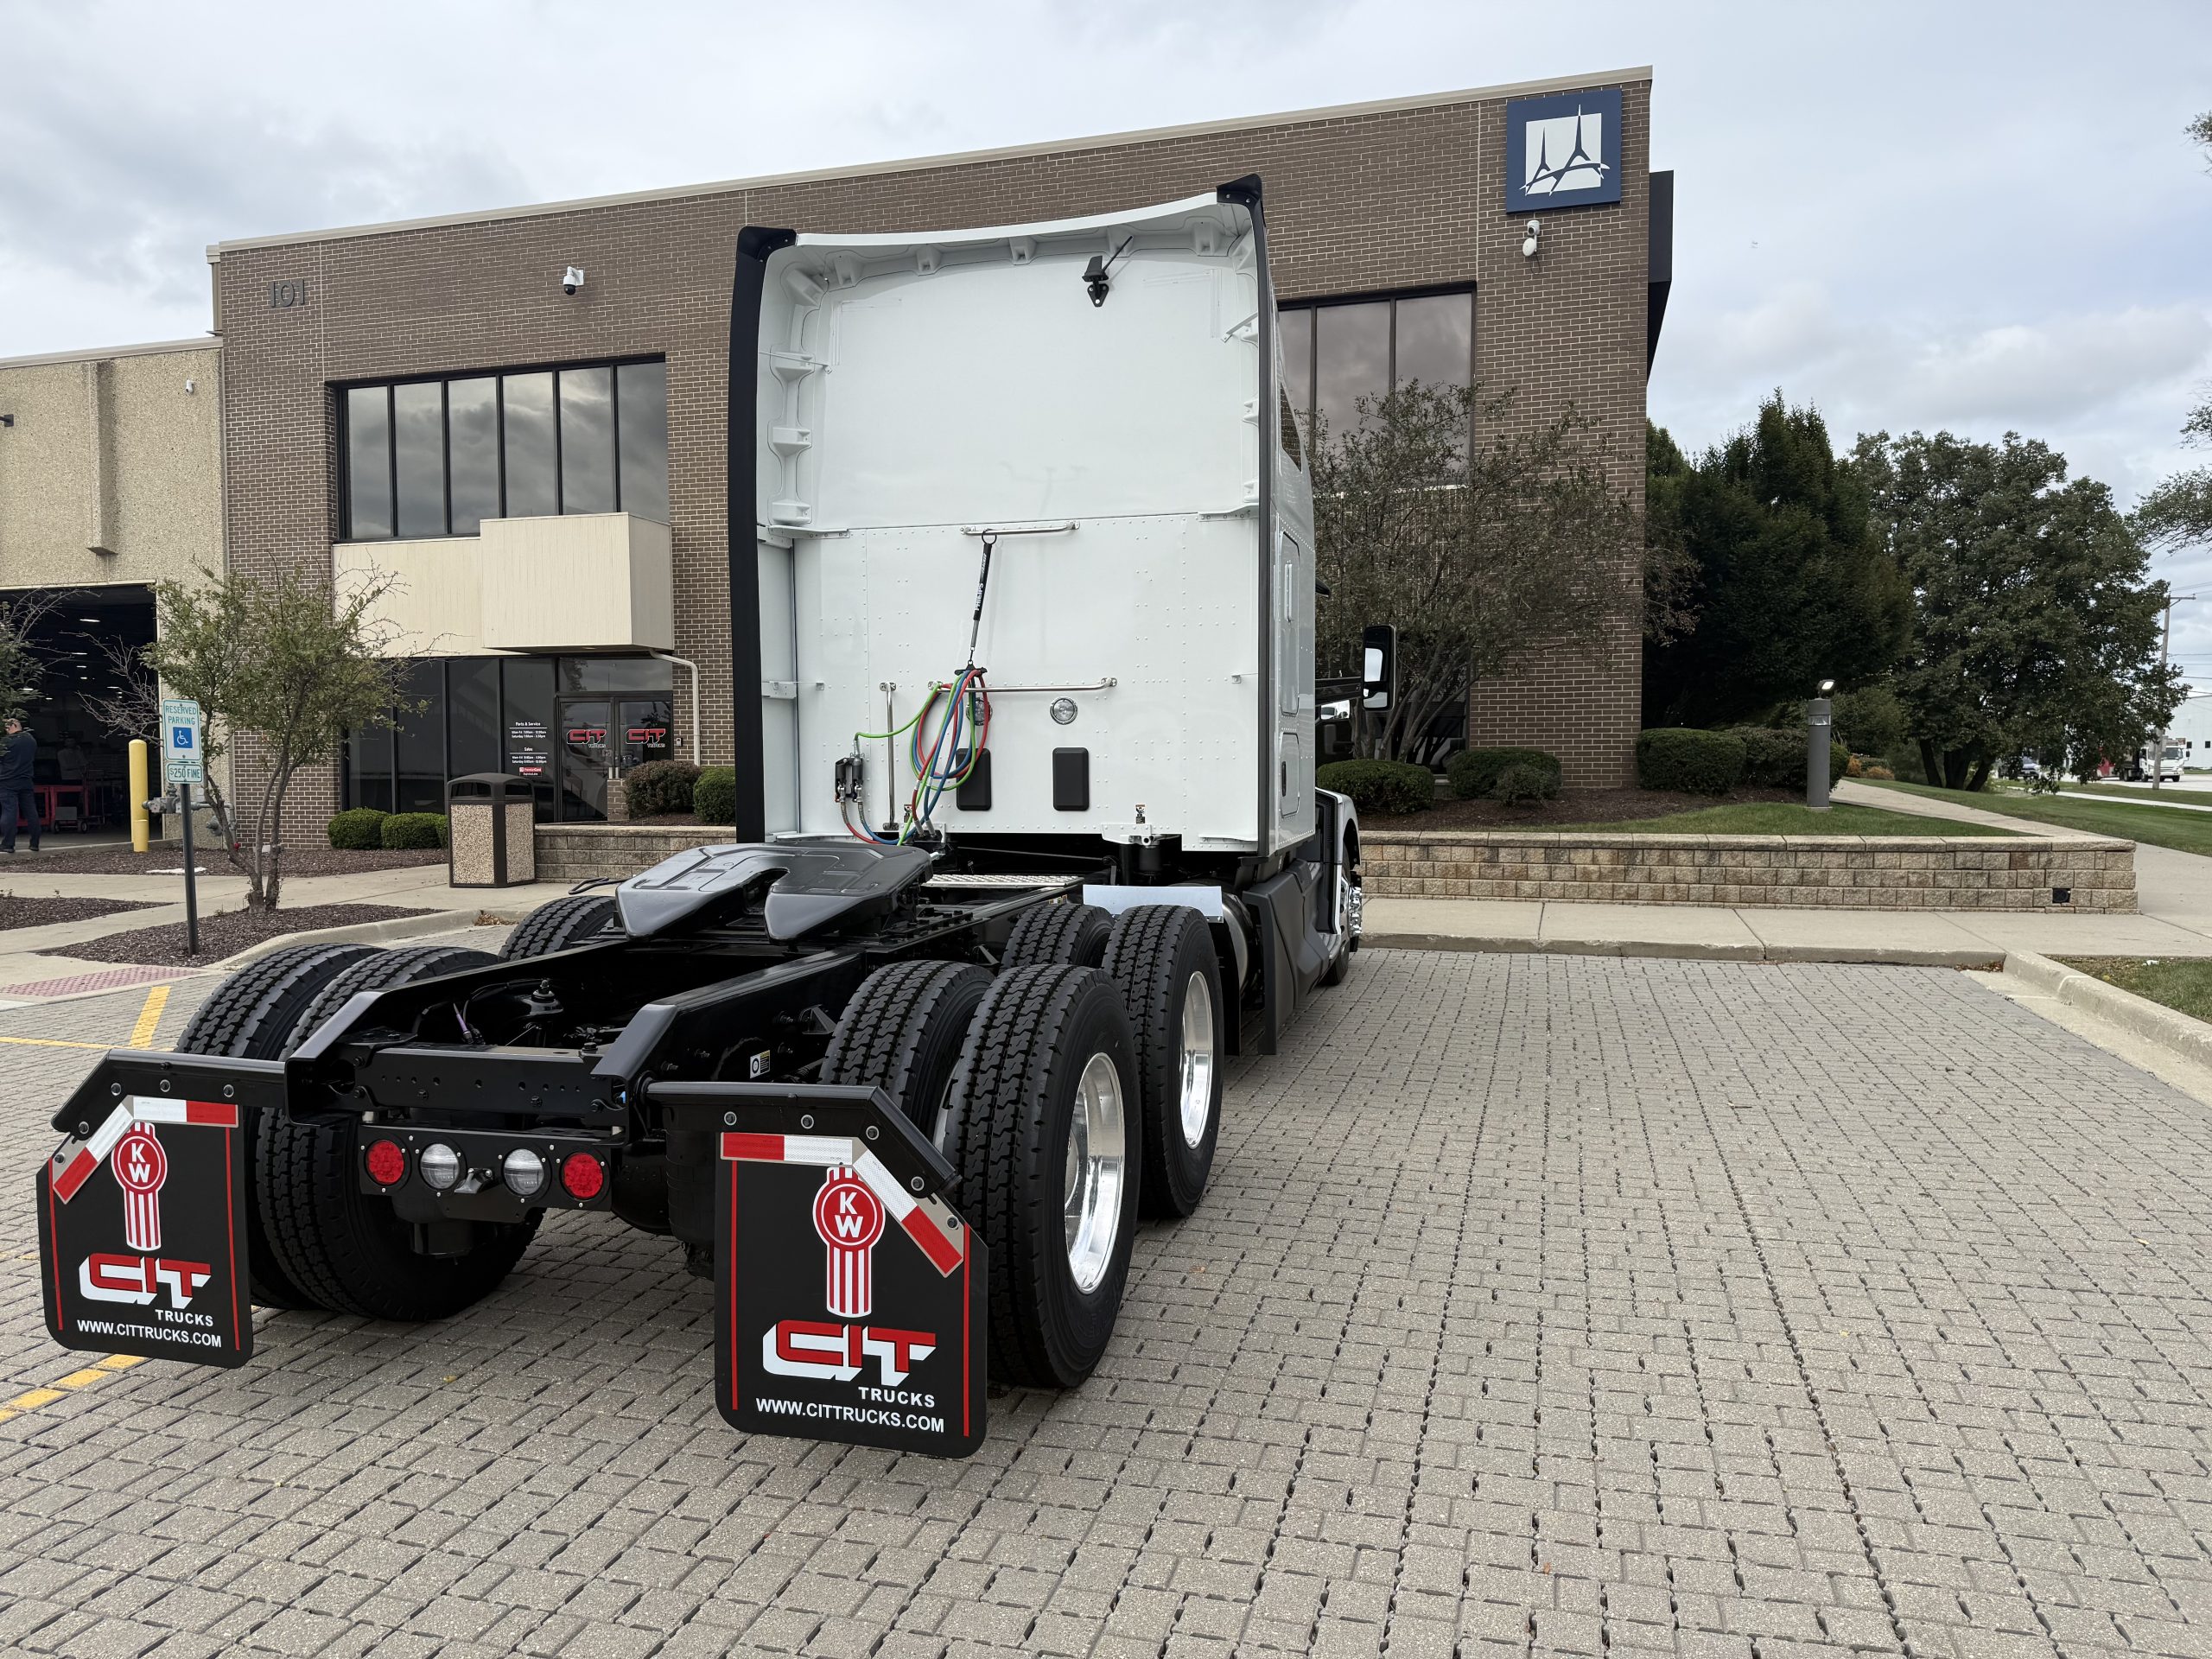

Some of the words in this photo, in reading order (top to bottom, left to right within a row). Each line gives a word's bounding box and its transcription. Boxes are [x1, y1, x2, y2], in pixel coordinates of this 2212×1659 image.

[267, 278, 305, 308] 101
[165, 705, 197, 715] RESERVED
[168, 715, 195, 725] PARKING
[567, 728, 607, 744] CIT
[626, 728, 666, 744] CIT
[169, 767, 187, 778] $250
[188, 769, 200, 779] FINE
[79, 1253, 212, 1309] CIT
[155, 1309, 213, 1327] TRUCKS
[77, 1319, 222, 1348] WWW.CITTRUCKS.COM
[763, 1319, 937, 1387] CIT
[858, 1386, 936, 1408] TRUCKS
[756, 1397, 944, 1433] WWW.CITTRUCKS.COM
